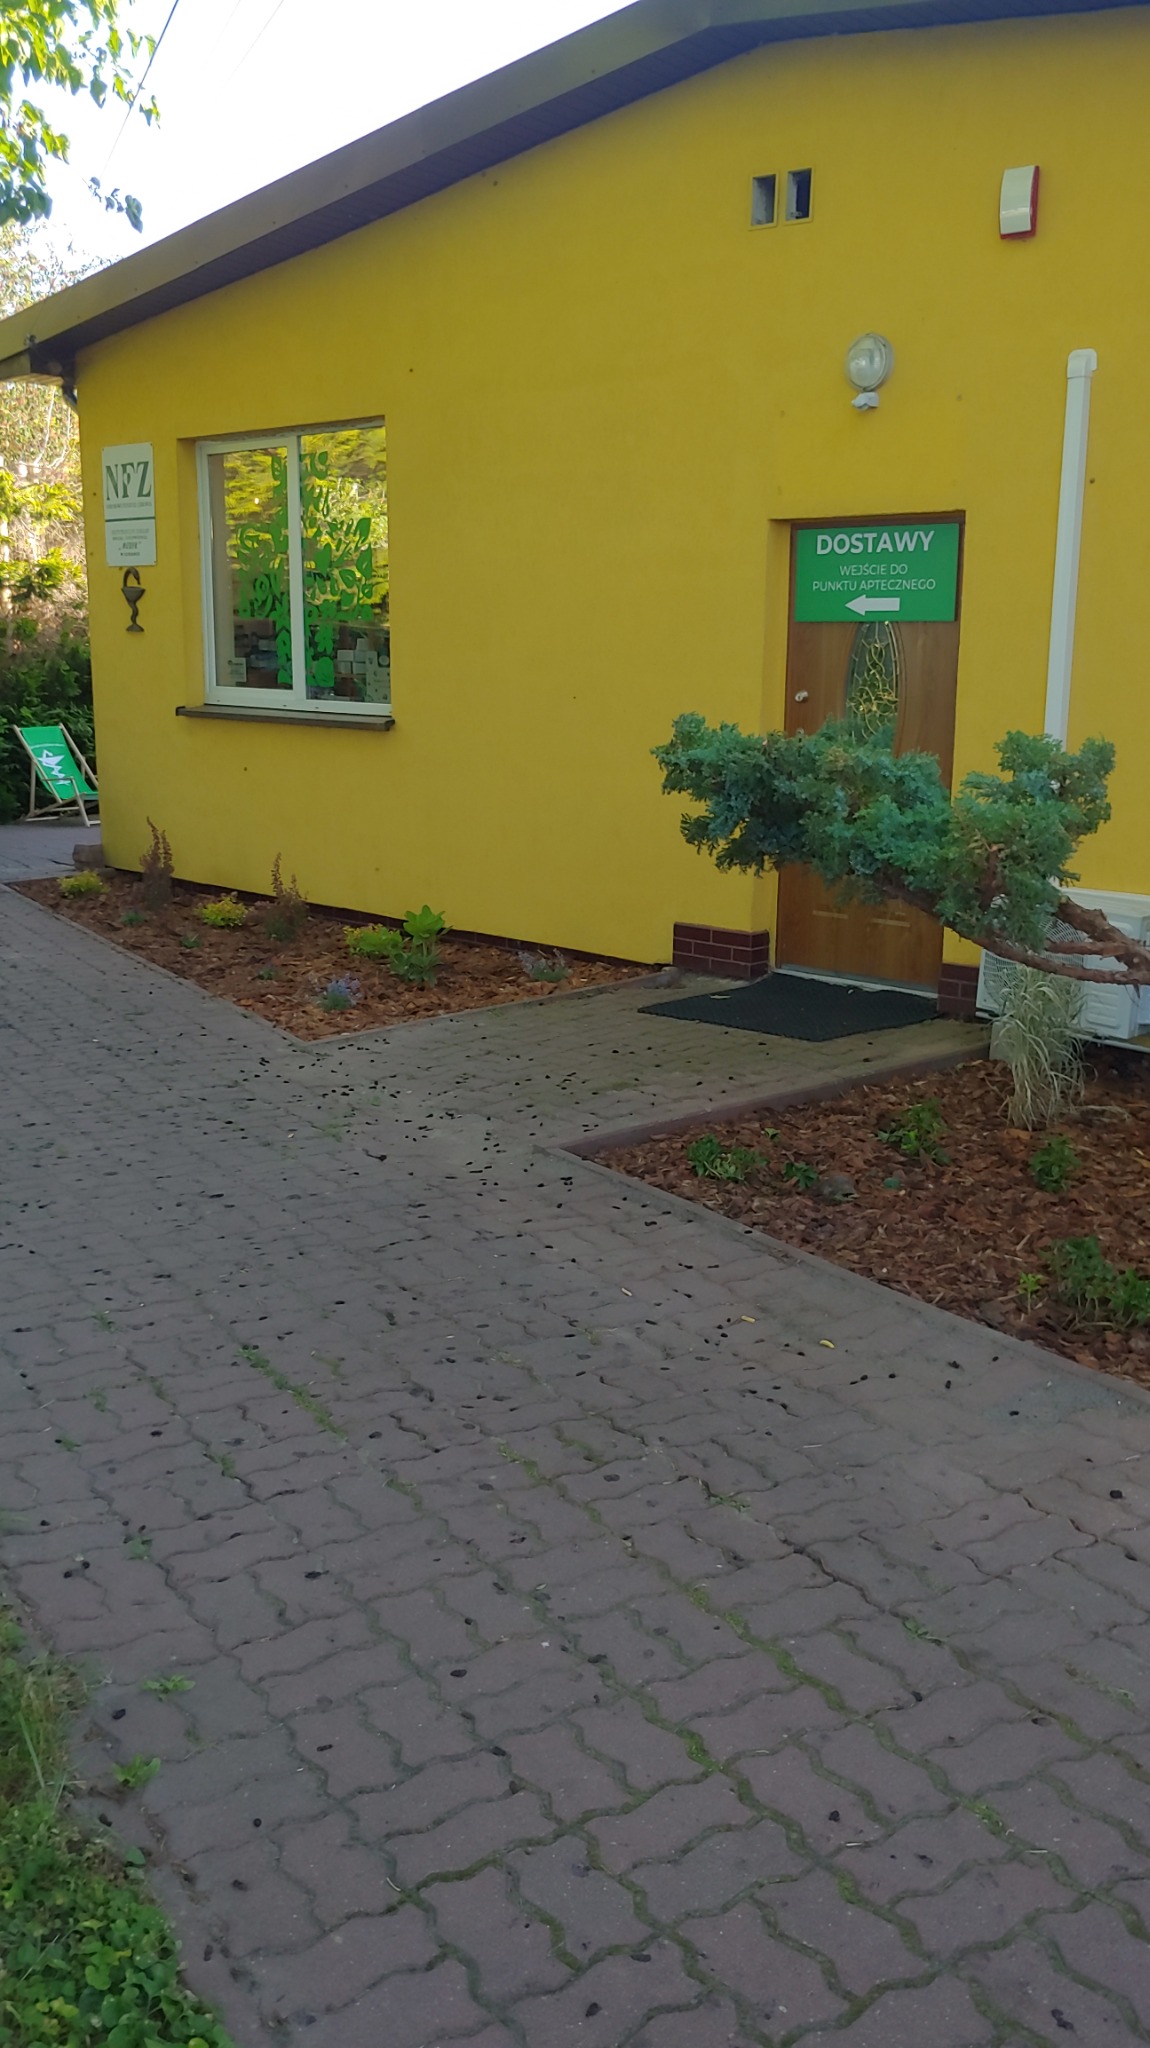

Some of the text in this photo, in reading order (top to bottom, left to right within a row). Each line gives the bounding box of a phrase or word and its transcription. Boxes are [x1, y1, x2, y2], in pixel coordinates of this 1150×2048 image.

[105, 461, 152, 501] NFZ
[816, 530, 935, 555] DOSTAWY
[839, 563, 908, 576] WEJŚCIE DO
[812, 578, 936, 592] PUNKTU APTECZNEGO
